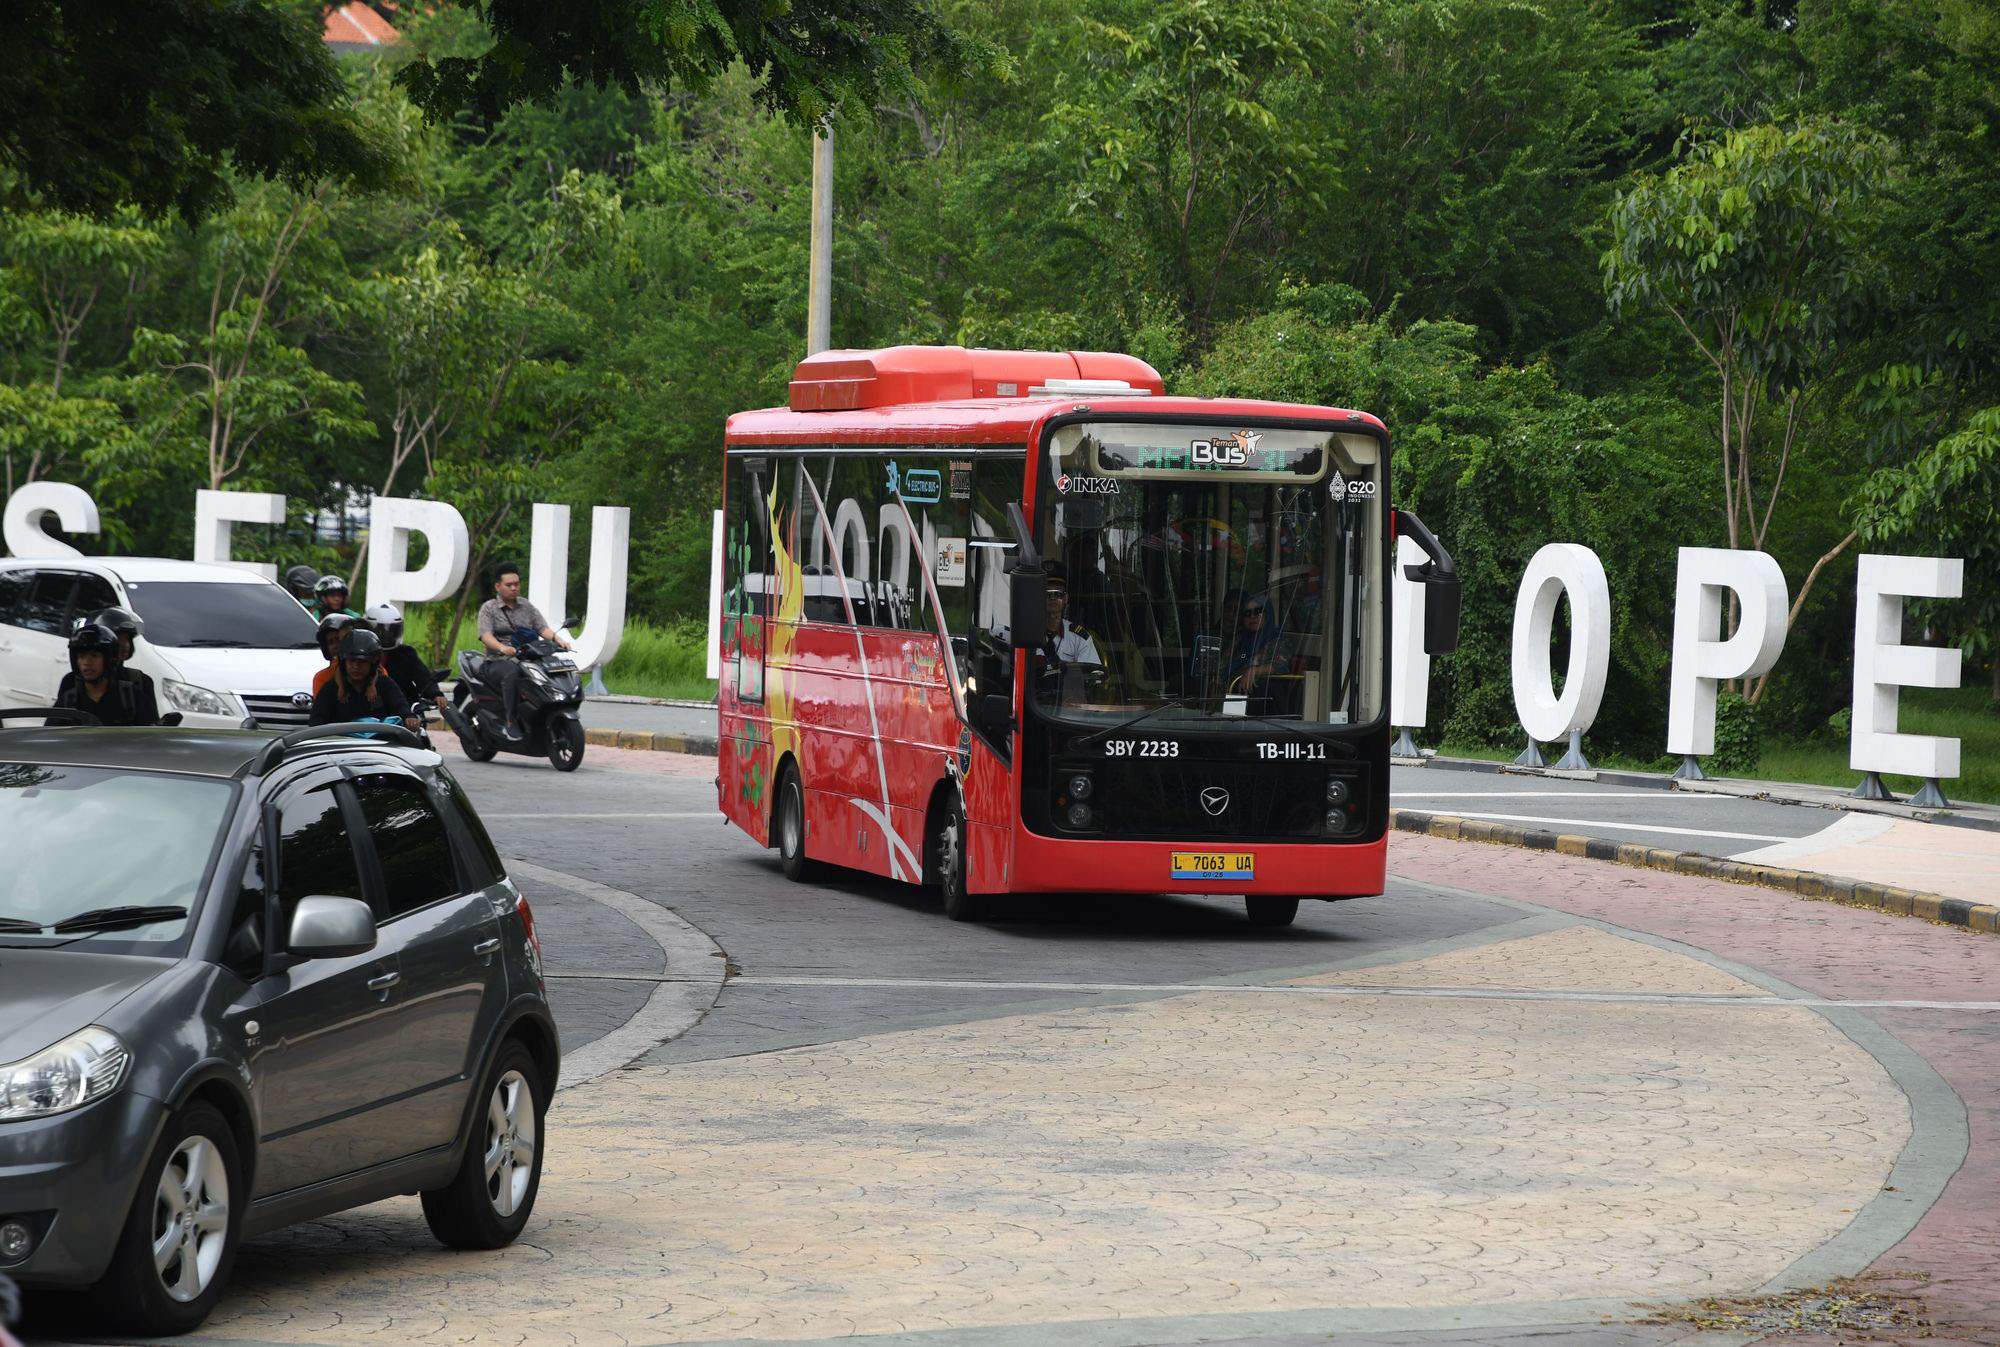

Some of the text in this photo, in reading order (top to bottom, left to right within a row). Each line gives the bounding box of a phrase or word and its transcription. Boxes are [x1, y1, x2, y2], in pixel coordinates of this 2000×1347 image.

[1212, 438, 1238, 447] Teman
[1191, 440, 1247, 465] Bus
[911, 480, 927, 492] ELECTRIC
[1074, 477, 1120, 494] INKA
[1348, 481, 1376, 494] G20
[1105, 740, 1179, 757] SBY 2233
[1256, 742, 1326, 759] TB-III-11
[1173, 855, 1252, 870] L 7063 UA
